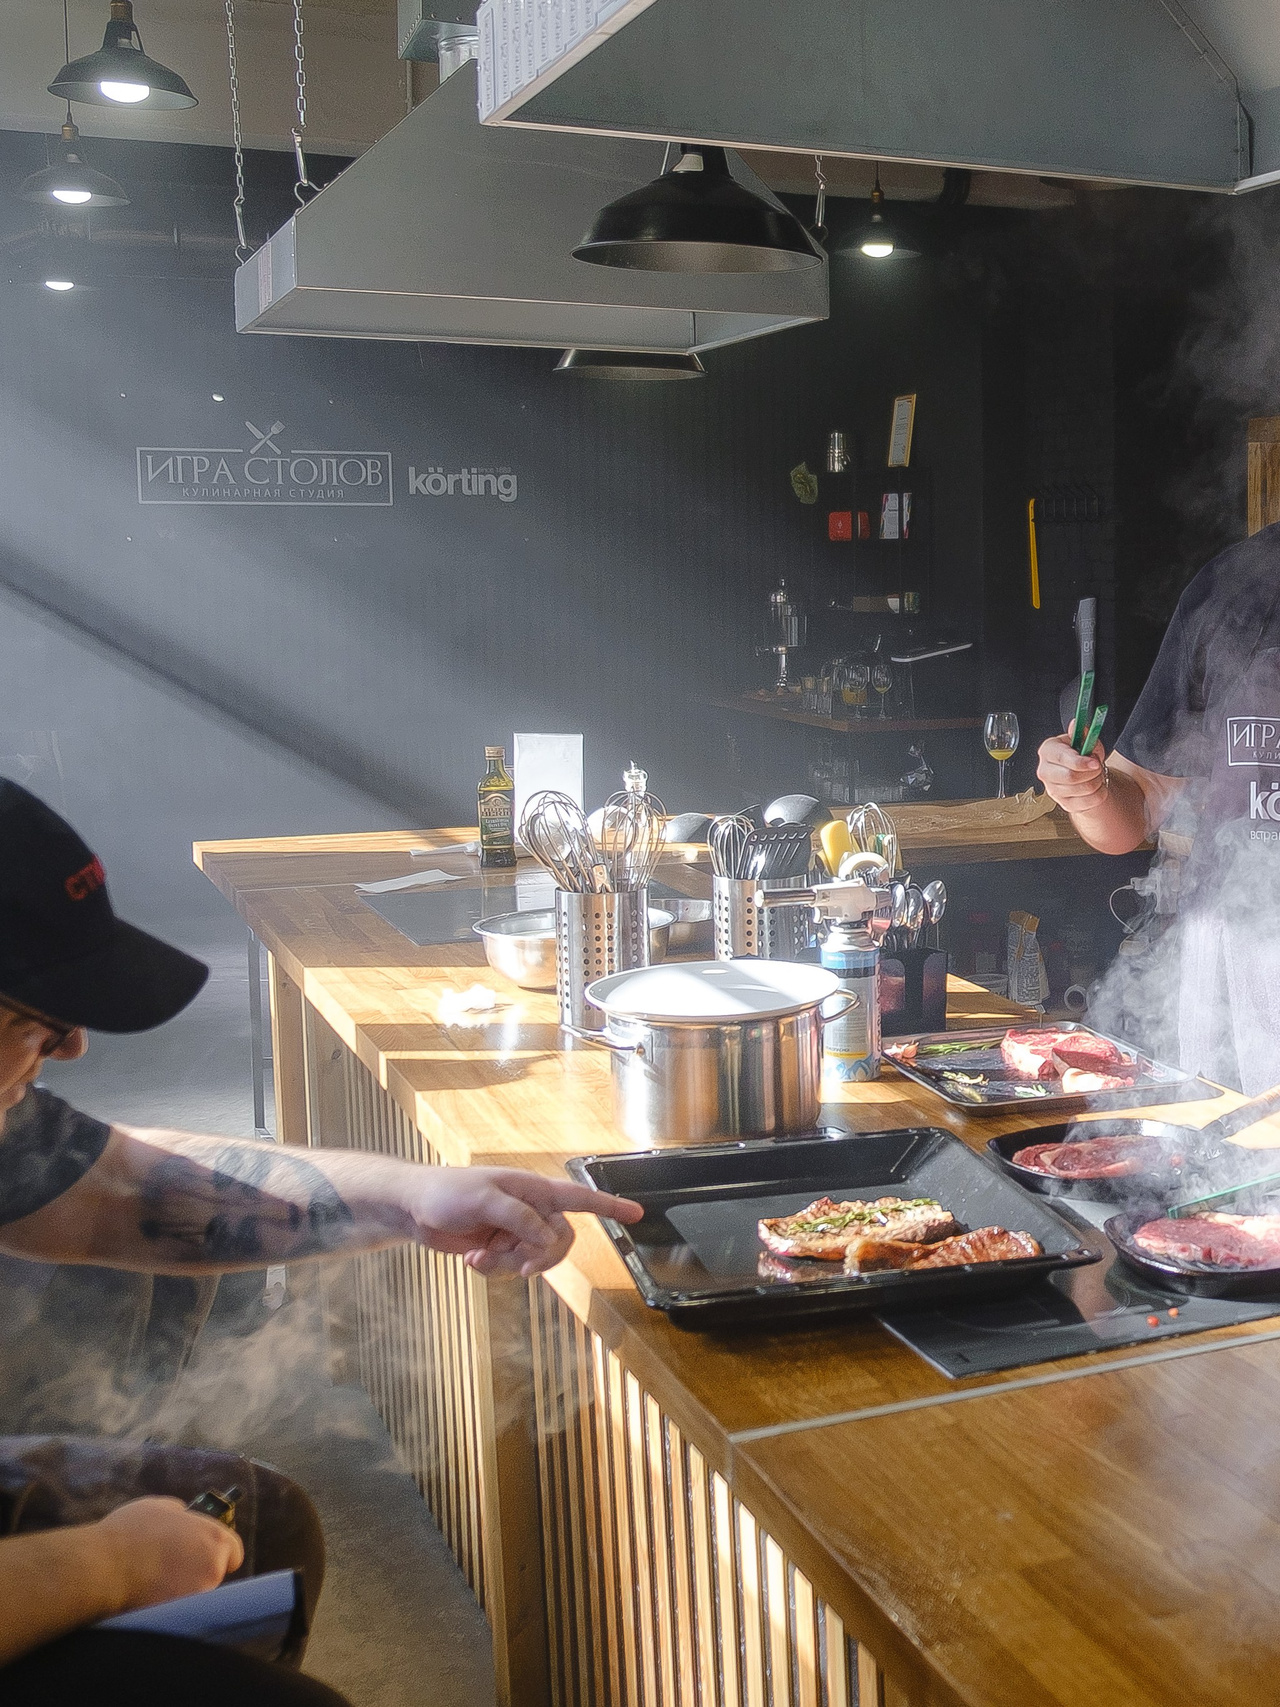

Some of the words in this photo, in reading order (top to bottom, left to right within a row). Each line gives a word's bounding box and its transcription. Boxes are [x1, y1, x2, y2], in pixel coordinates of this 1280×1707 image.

[146, 454, 237, 484] ИГРА
[244, 456, 384, 487] СТОЛОВ
[408, 466, 518, 503] körting
[182, 487, 282, 499] КУЛИНАРНАЯ
[289, 489, 345, 500] СТУДИЯ
